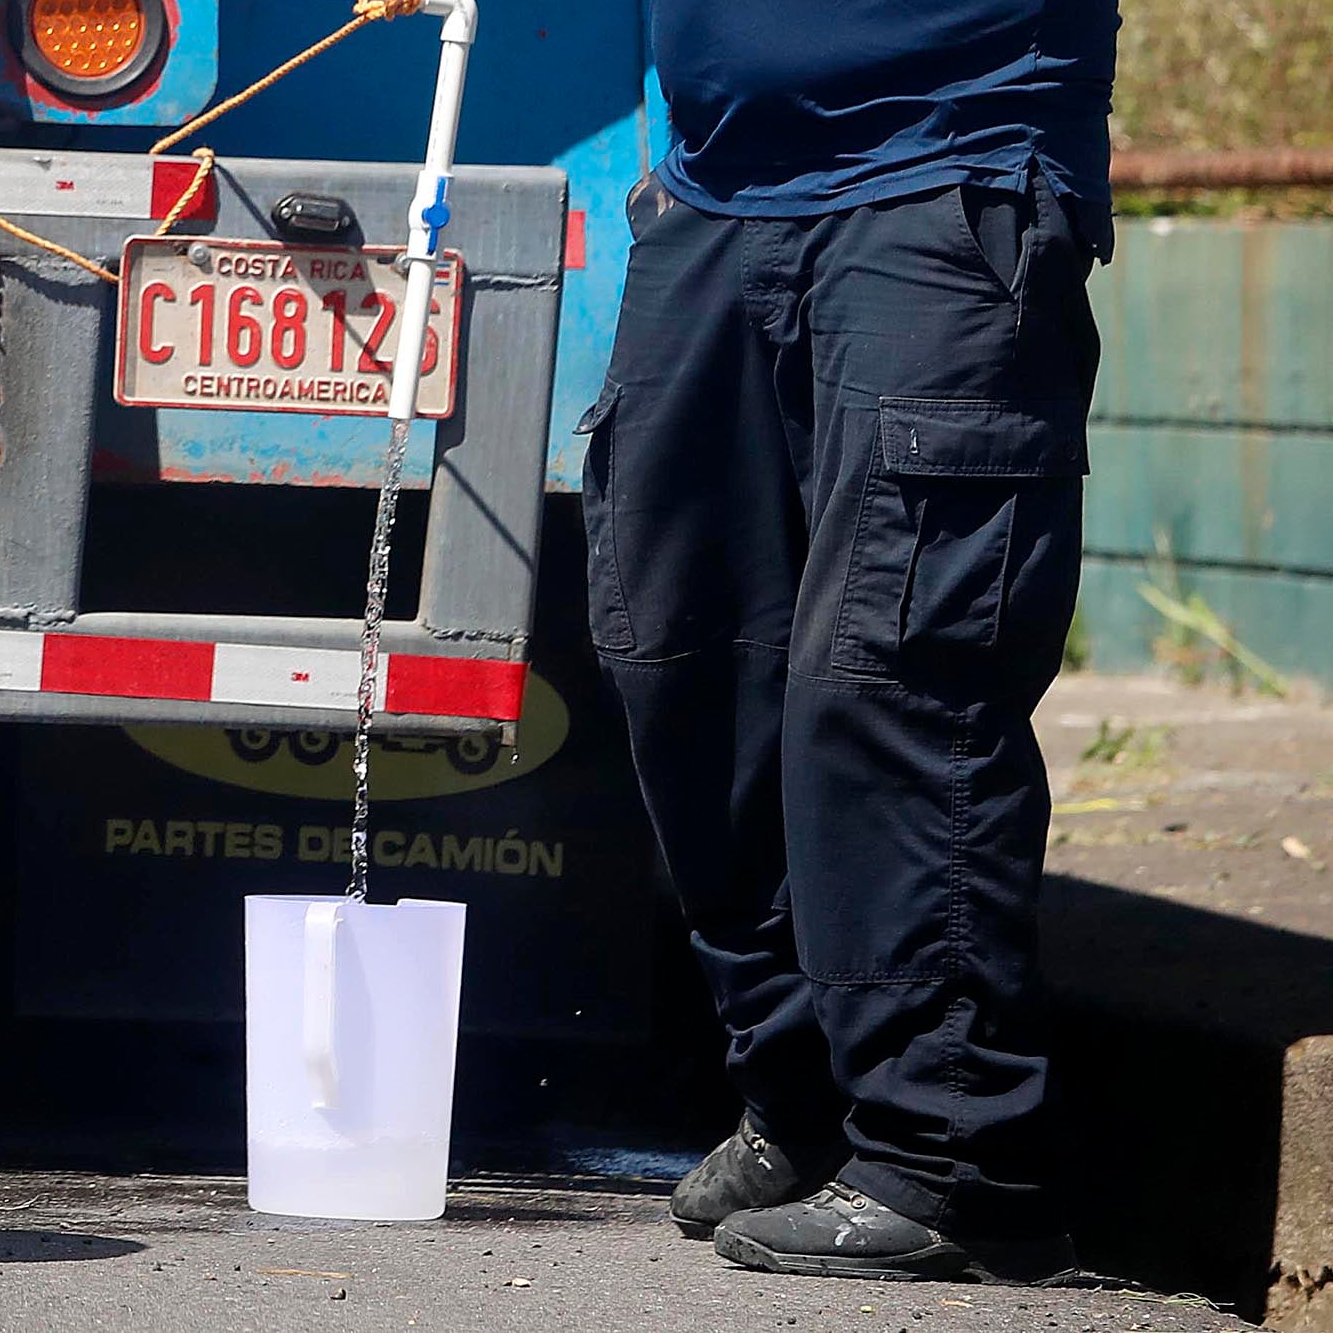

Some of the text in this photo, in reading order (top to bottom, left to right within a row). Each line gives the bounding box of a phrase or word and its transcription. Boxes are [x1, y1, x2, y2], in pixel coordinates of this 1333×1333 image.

[55, 180, 75, 192] 3M
[217, 255, 366, 281] COSTA RICA
[184, 375, 389, 404] CENTROAMERICA
[290, 671, 311, 683] 3M
[105, 818, 564, 877] PARTES DE CAMIÓN
